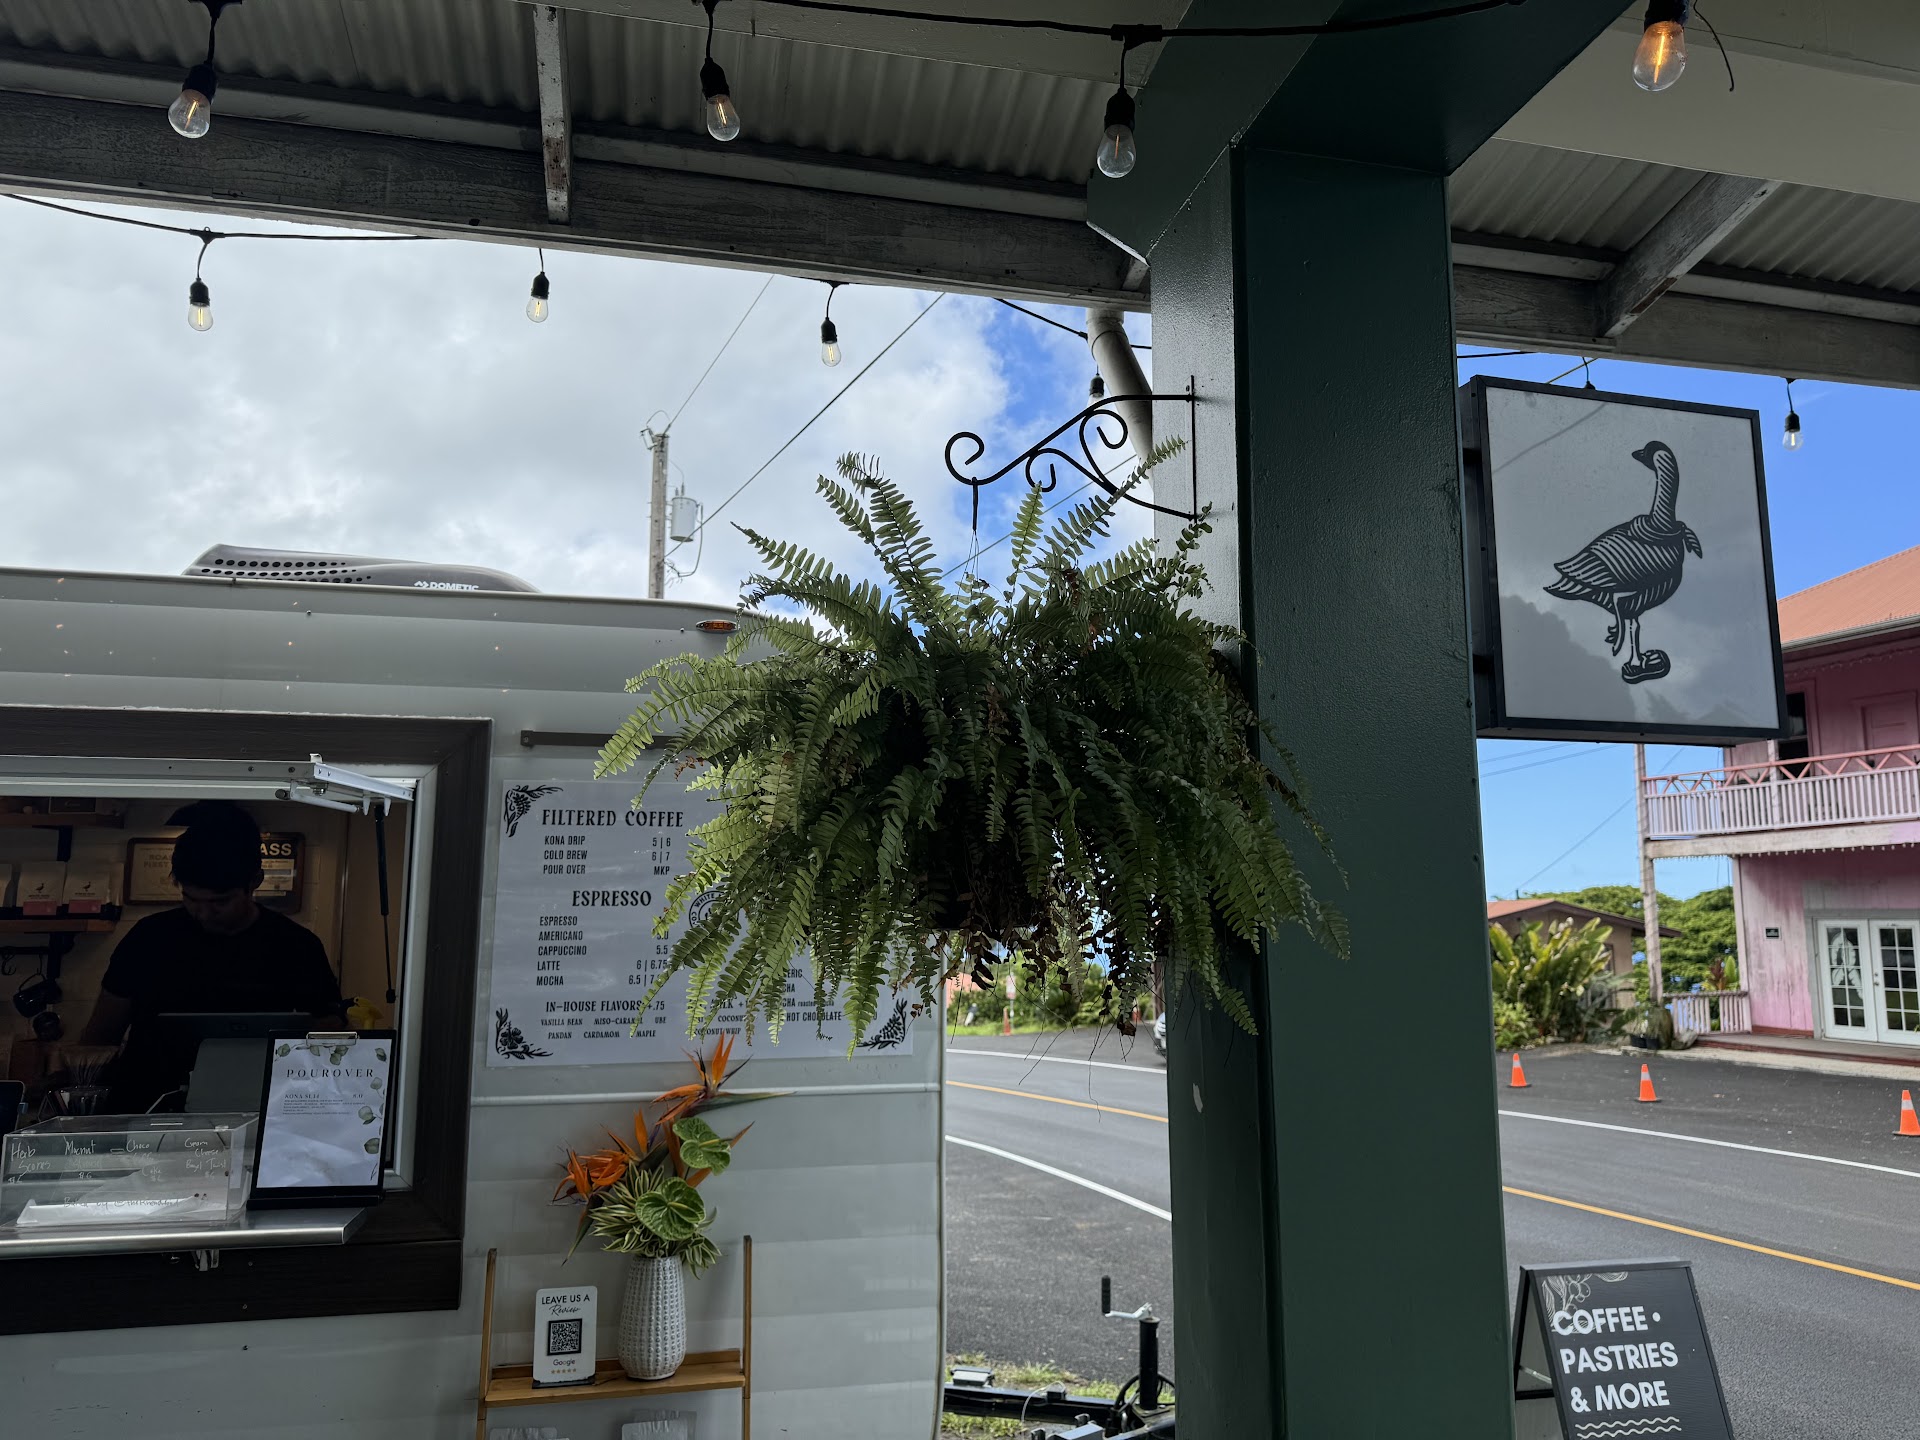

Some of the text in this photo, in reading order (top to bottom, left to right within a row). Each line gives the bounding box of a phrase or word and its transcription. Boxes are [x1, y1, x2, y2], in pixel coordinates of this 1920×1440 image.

[542, 809, 684, 827] FILTERED COFFEE
[544, 835, 586, 846] KONA DRIP
[652, 837, 658, 847] 5
[666, 838, 671, 847] 6
[260, 843, 292, 856] ASS
[544, 850, 588, 860] COLD BREW
[651, 852, 657, 861] 6
[666, 852, 670, 861] 7
[543, 864, 586, 874] POUR OVER
[653, 866, 670, 875] MKP
[572, 890, 652, 907] ESPRESSO
[539, 916, 578, 926] ESPRESSO
[538, 930, 583, 941] AMERICANO
[538, 945, 587, 956] CAPPUCCINO
[656, 945, 668, 955] 5.5
[537, 960, 561, 971] LATTE
[636, 960, 642, 969] 6
[536, 975, 564, 986] MOCHA
[628, 975, 641, 985] 6.5
[546, 1000, 597, 1012] IN-HOUSE
[541, 1018, 565, 1026] VANILLA
[567, 1018, 583, 1026] BEAN
[594, 1016, 643, 1025] MISO-CARAML
[786, 1011, 842, 1021] HOT CHOOLATE
[548, 1031, 572, 1039] PANDAN
[636, 1030, 657, 1038] MAPLE
[286, 1068, 374, 1078] POUROVER
[541, 1294, 590, 1304] LEAVE US A
[549, 1304, 582, 1316] Review
[1553, 1306, 1648, 1335] COFFEE
[553, 1358, 576, 1367] Google
[1560, 1342, 1679, 1374] PASTRIES
[1571, 1380, 1670, 1413] & MORE
